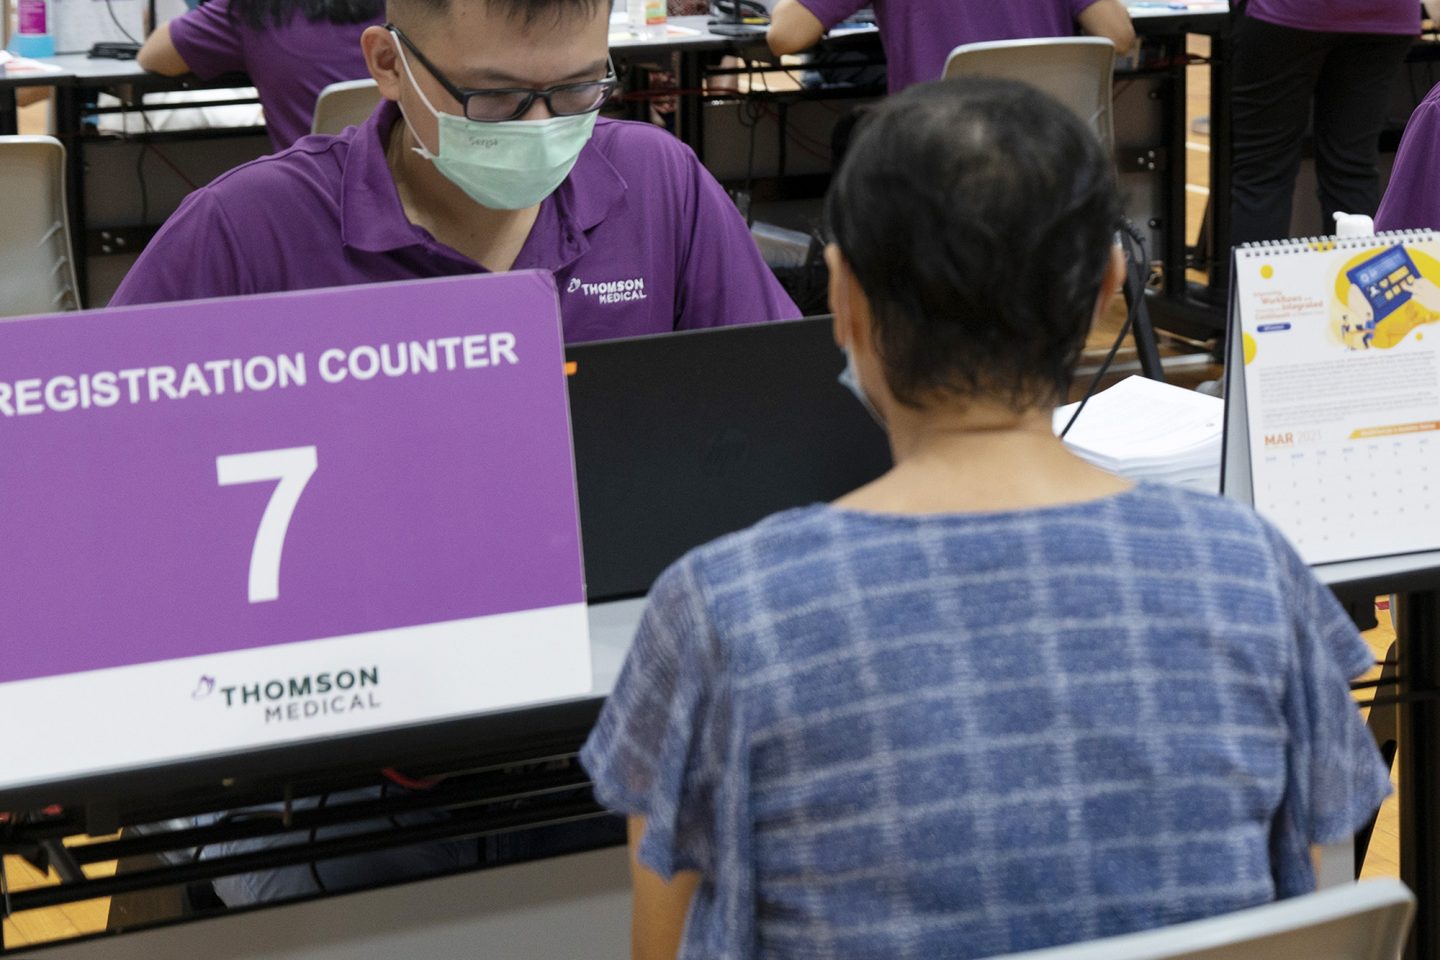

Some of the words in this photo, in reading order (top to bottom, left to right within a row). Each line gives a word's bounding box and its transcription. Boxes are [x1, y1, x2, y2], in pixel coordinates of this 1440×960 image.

[581, 277, 645, 296] THOMSON
[598, 289, 647, 305] MEDICAL
[0, 351, 308, 417] REGISTRATION
[318, 331, 520, 383] COUNTER
[1264, 432, 1294, 447] MAR
[215, 444, 319, 604] 7
[220, 665, 380, 708] THOMSON
[264, 691, 382, 724] MEDICAL
